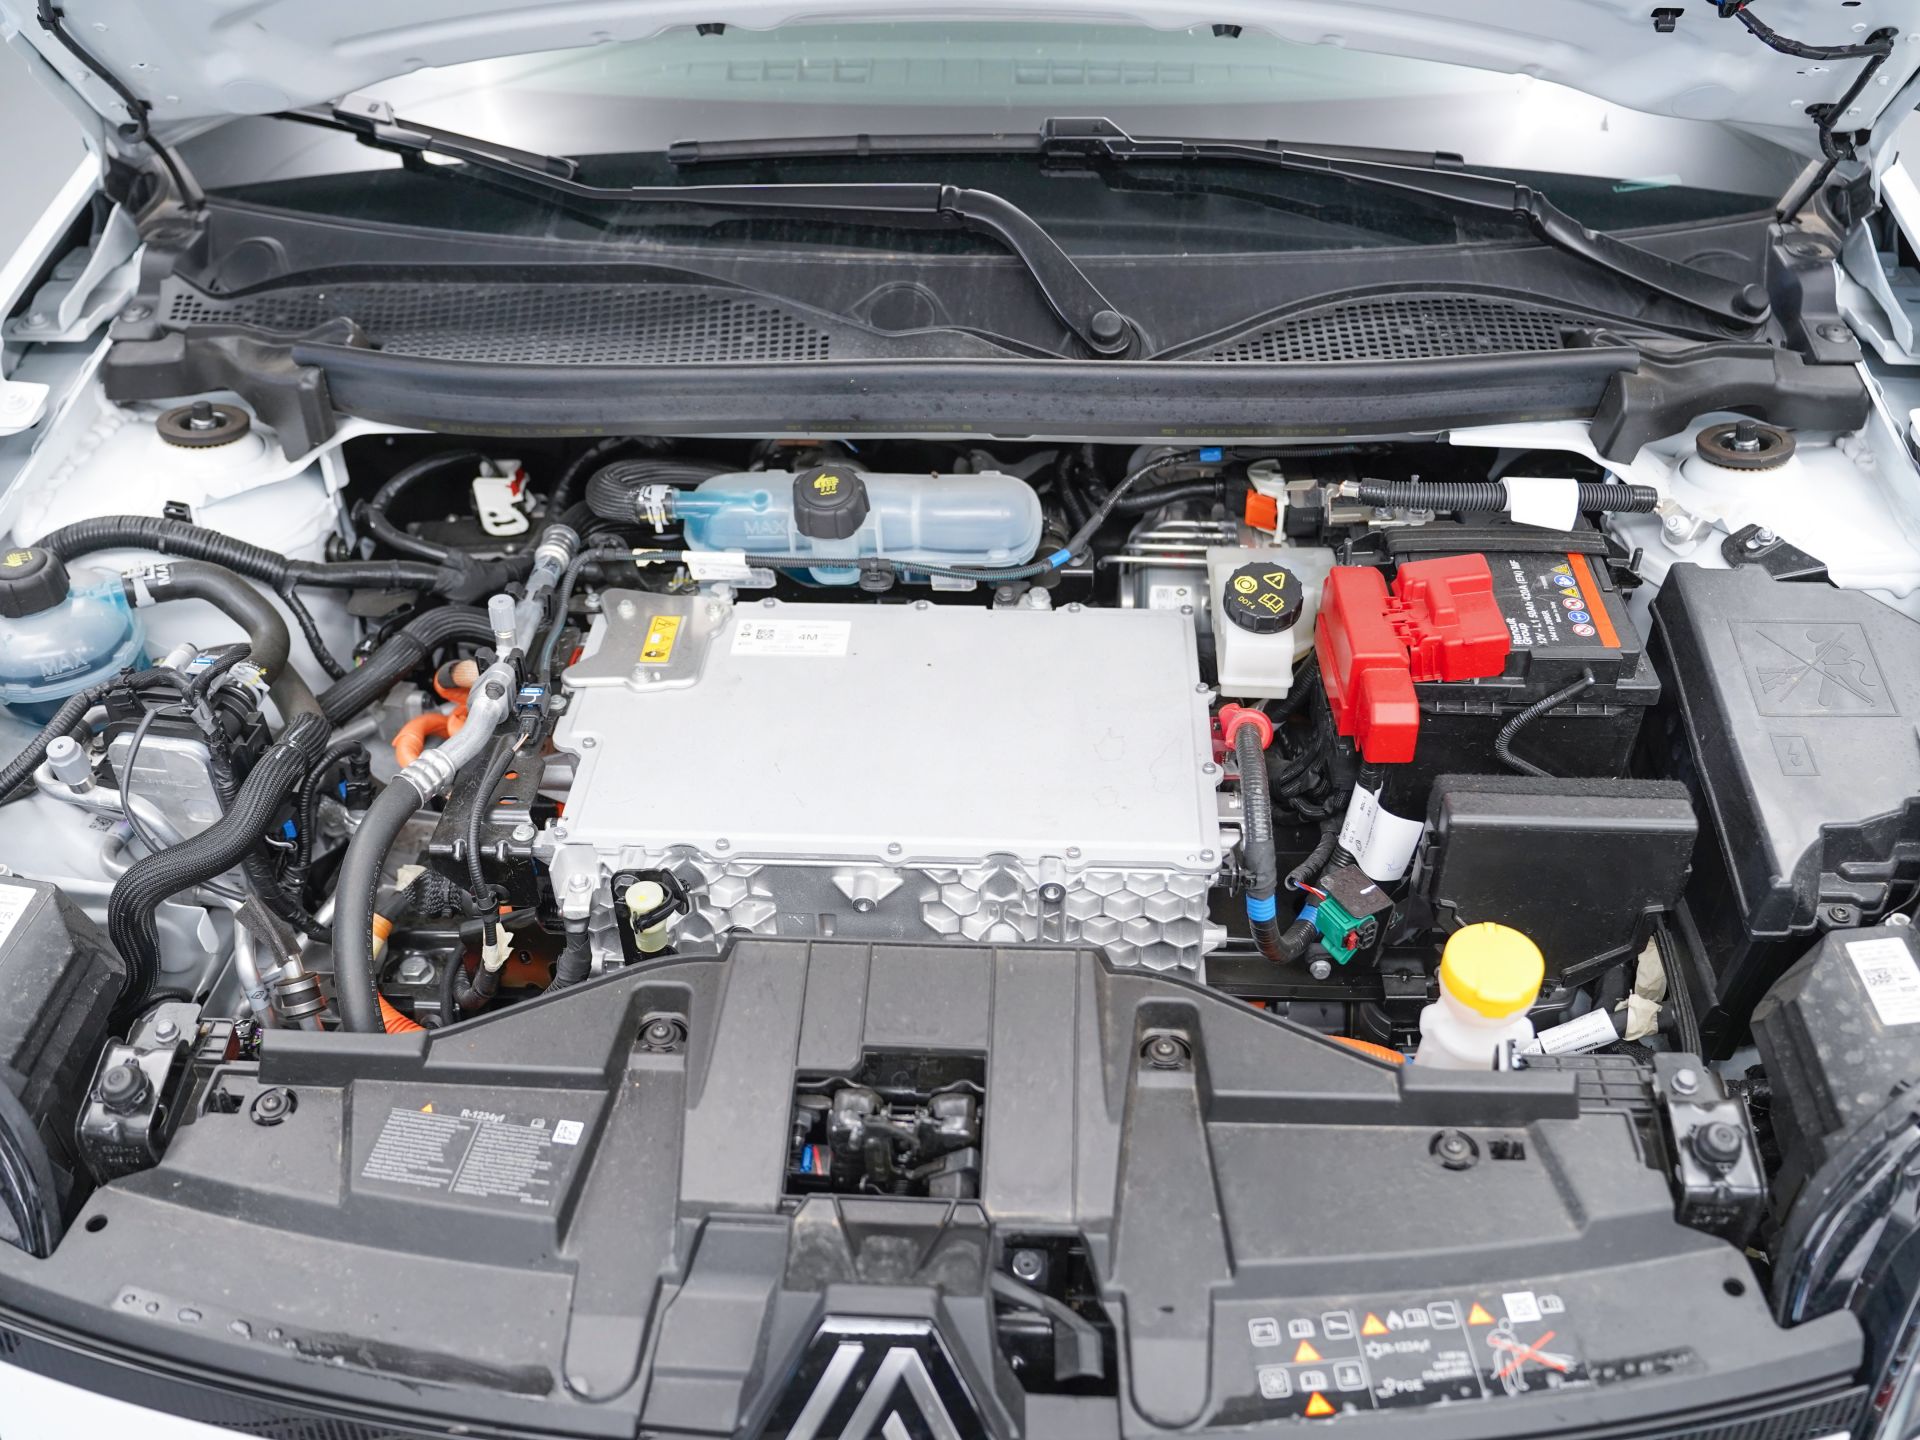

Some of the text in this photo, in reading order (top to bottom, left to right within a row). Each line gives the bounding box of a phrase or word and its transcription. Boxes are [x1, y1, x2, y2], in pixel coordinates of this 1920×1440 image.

[743, 519, 787, 535] MAX
[1513, 570, 1528, 584] (EN)
[1518, 584, 1532, 601] 420A
[1524, 601, 1539, 619] 50Ah
[798, 633, 818, 641] 4M
[1506, 617, 1524, 645] Renault
[1518, 622, 1533, 645] Group
[1535, 632, 1548, 645] 12V
[40, 653, 87, 676] MAX
[460, 1109, 506, 1122] R-1234yf
